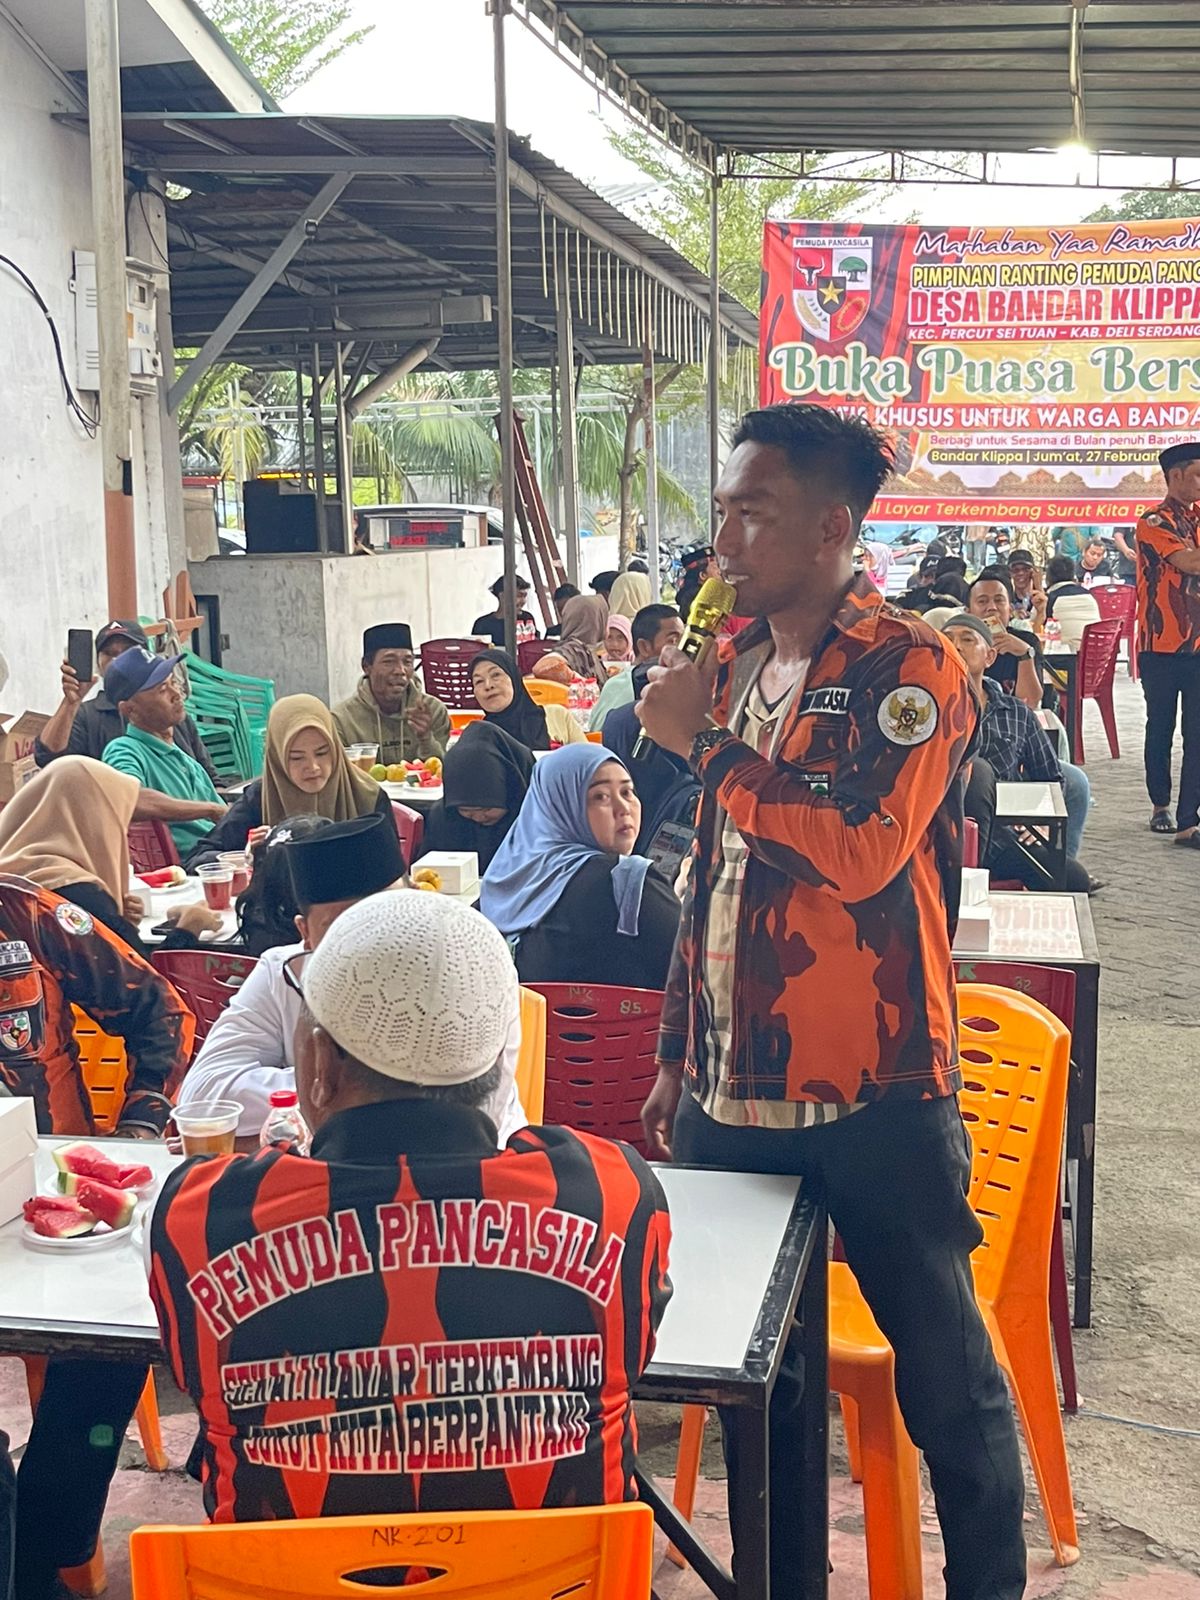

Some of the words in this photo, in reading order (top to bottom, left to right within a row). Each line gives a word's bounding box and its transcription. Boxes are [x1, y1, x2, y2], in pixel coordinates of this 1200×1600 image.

[914, 229, 1042, 255] Marhaban
[1051, 230, 1097, 258] Yaa
[912, 265, 995, 287] PIMPINAN
[1000, 263, 1078, 286] RANTING
[1082, 261, 1152, 285] PEMUDA
[910, 290, 980, 324] DESA
[988, 289, 1103, 322] BANDAR
[908, 328, 938, 340] KEC.
[941, 327, 996, 340] PERCUT
[997, 327, 1018, 339] SEI
[1019, 326, 1057, 339] TUAN
[1070, 327, 1102, 339] KAB.
[1106, 326, 1135, 338] DELI
[771, 344, 911, 403] Buka
[918, 346, 1076, 393] Puasa
[876, 406, 955, 428] KHUSUS
[962, 406, 1030, 428] UNTUK
[1037, 406, 1121, 428] WARGA
[977, 434, 1007, 446] untuk
[1011, 435, 1057, 446] Sesama
[1060, 434, 1070, 446] di
[1074, 434, 1105, 446] Bulan
[1109, 434, 1144, 449] penuh
[931, 450, 978, 462] Bandar
[981, 450, 1023, 464] Klippa
[1086, 451, 1101, 462] 27
[1104, 450, 1160, 463] Februari
[885, 503, 930, 519] Layar
[936, 503, 1041, 521] Terkembang
[1047, 504, 1092, 518] Surut
[1096, 503, 1130, 517] Kita
[187, 1208, 374, 1340] PEMUDA
[376, 1199, 625, 1307] PANCASILA
[420, 1334, 604, 1397] TERKEMBANG
[404, 1391, 591, 1474] BERPANTANG
